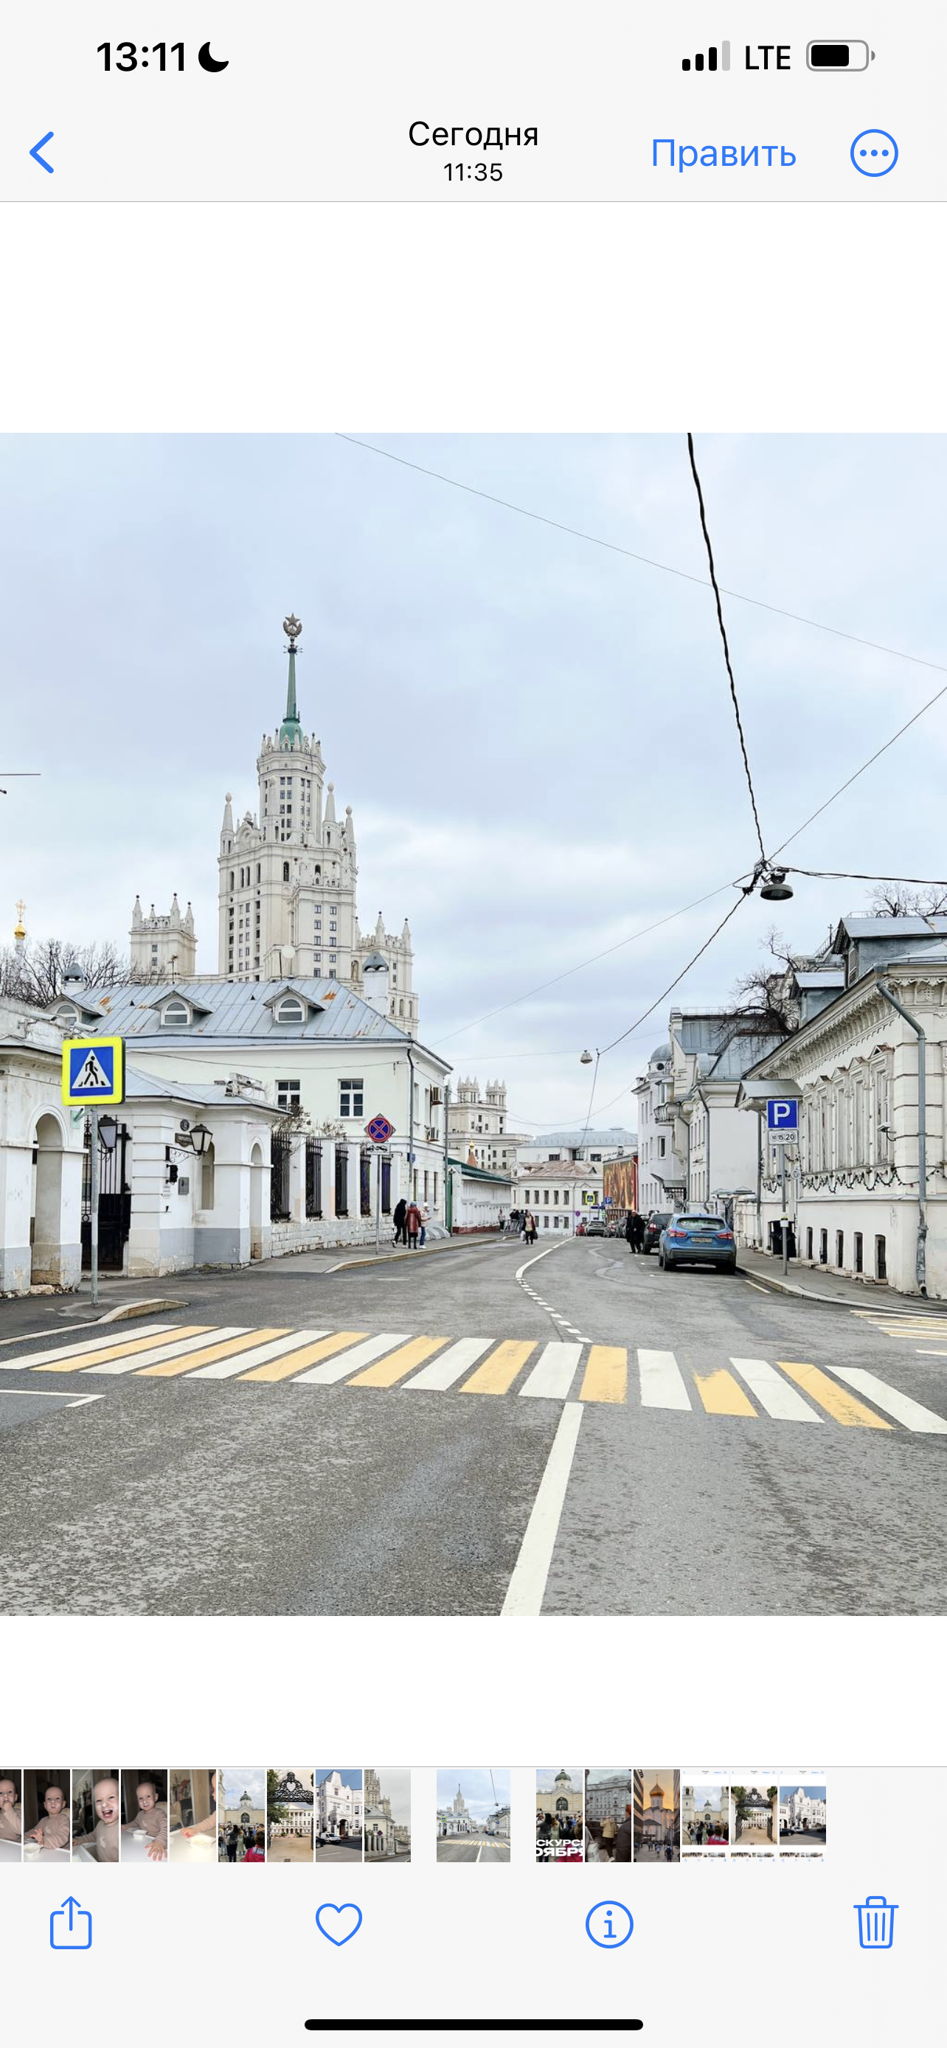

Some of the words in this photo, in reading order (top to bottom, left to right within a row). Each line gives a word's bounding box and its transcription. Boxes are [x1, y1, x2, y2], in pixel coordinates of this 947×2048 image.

[96, 41, 185, 73] 13:11
[744, 44, 792, 71] LTE
[408, 120, 538, 151] Сегодня
[652, 138, 797, 174] Править
[443, 162, 504, 182] 11:35
[773, 1102, 791, 1126] P
